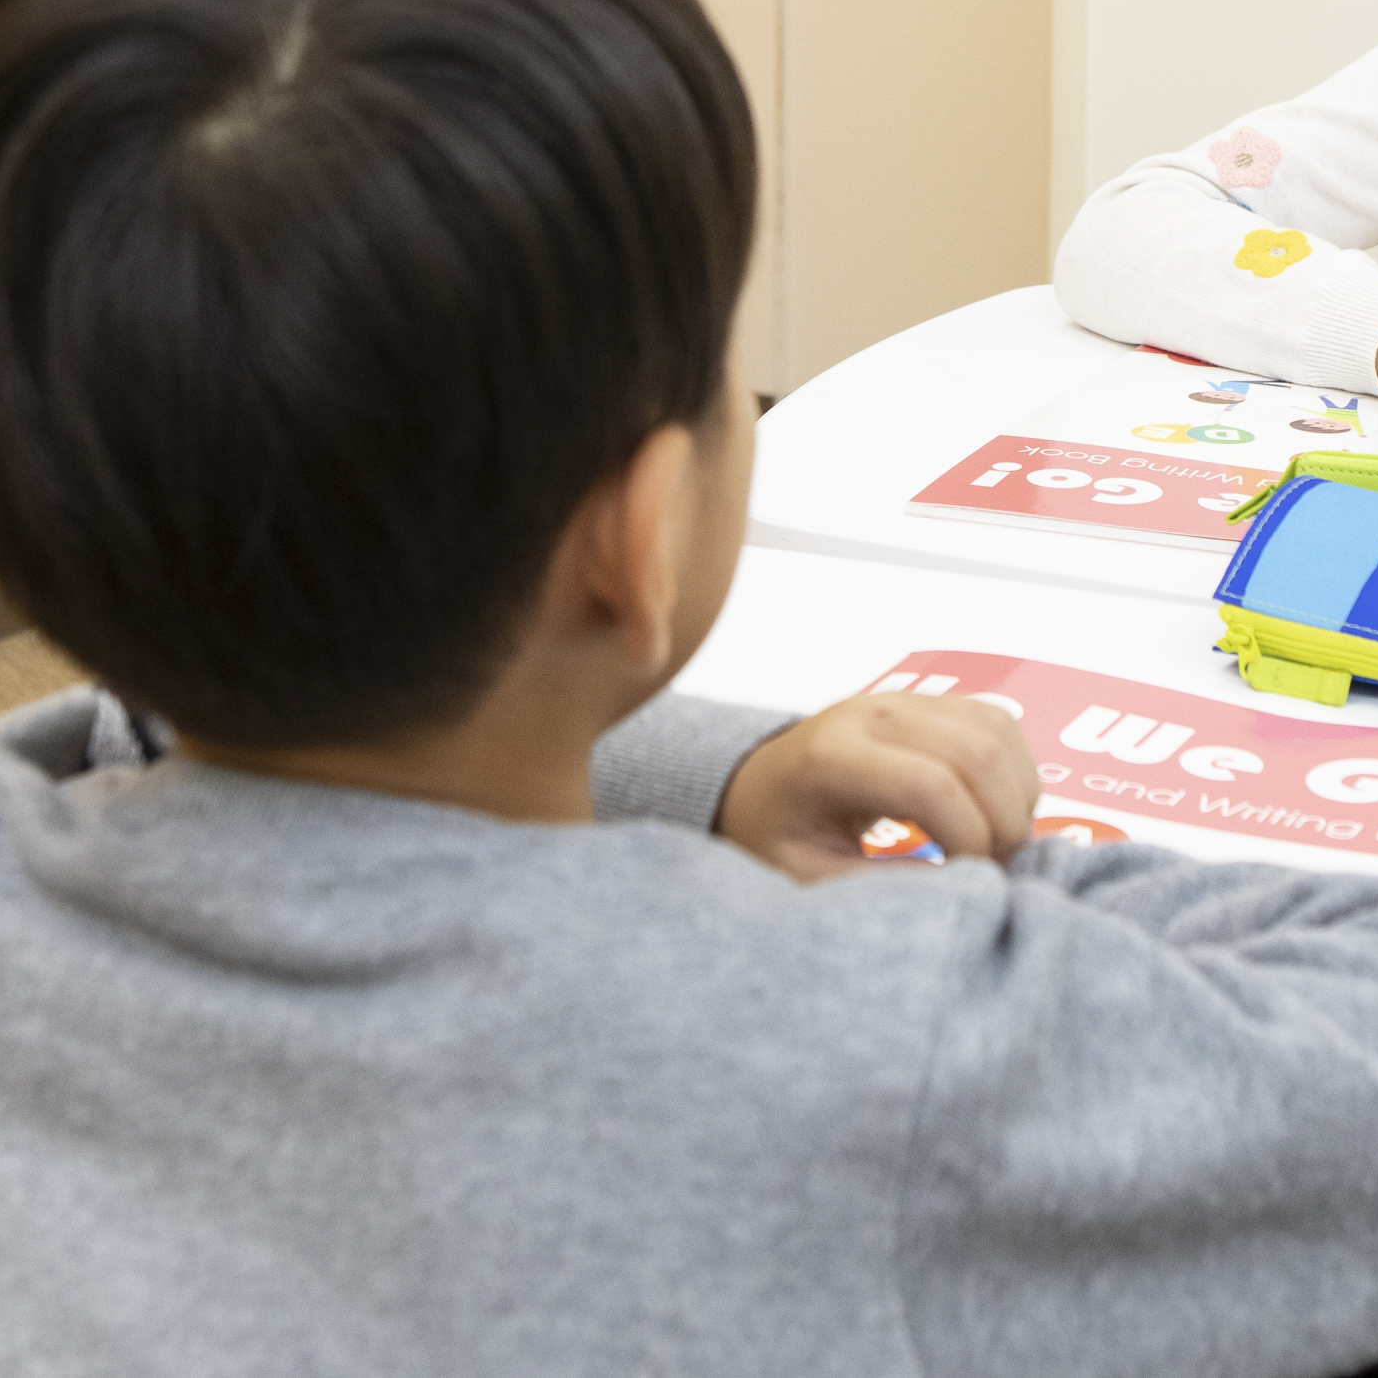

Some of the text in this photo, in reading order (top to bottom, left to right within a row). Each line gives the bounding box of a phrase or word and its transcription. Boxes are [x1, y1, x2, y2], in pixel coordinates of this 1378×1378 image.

[1135, 426, 1241, 441] D E
[1018, 444, 1112, 465] Book
[1120, 456, 1244, 485] Writing
[969, 461, 1164, 505] Go!
[1059, 704, 1265, 782] We
[1082, 773, 1187, 808] and
[1198, 792, 1364, 841] Writing
